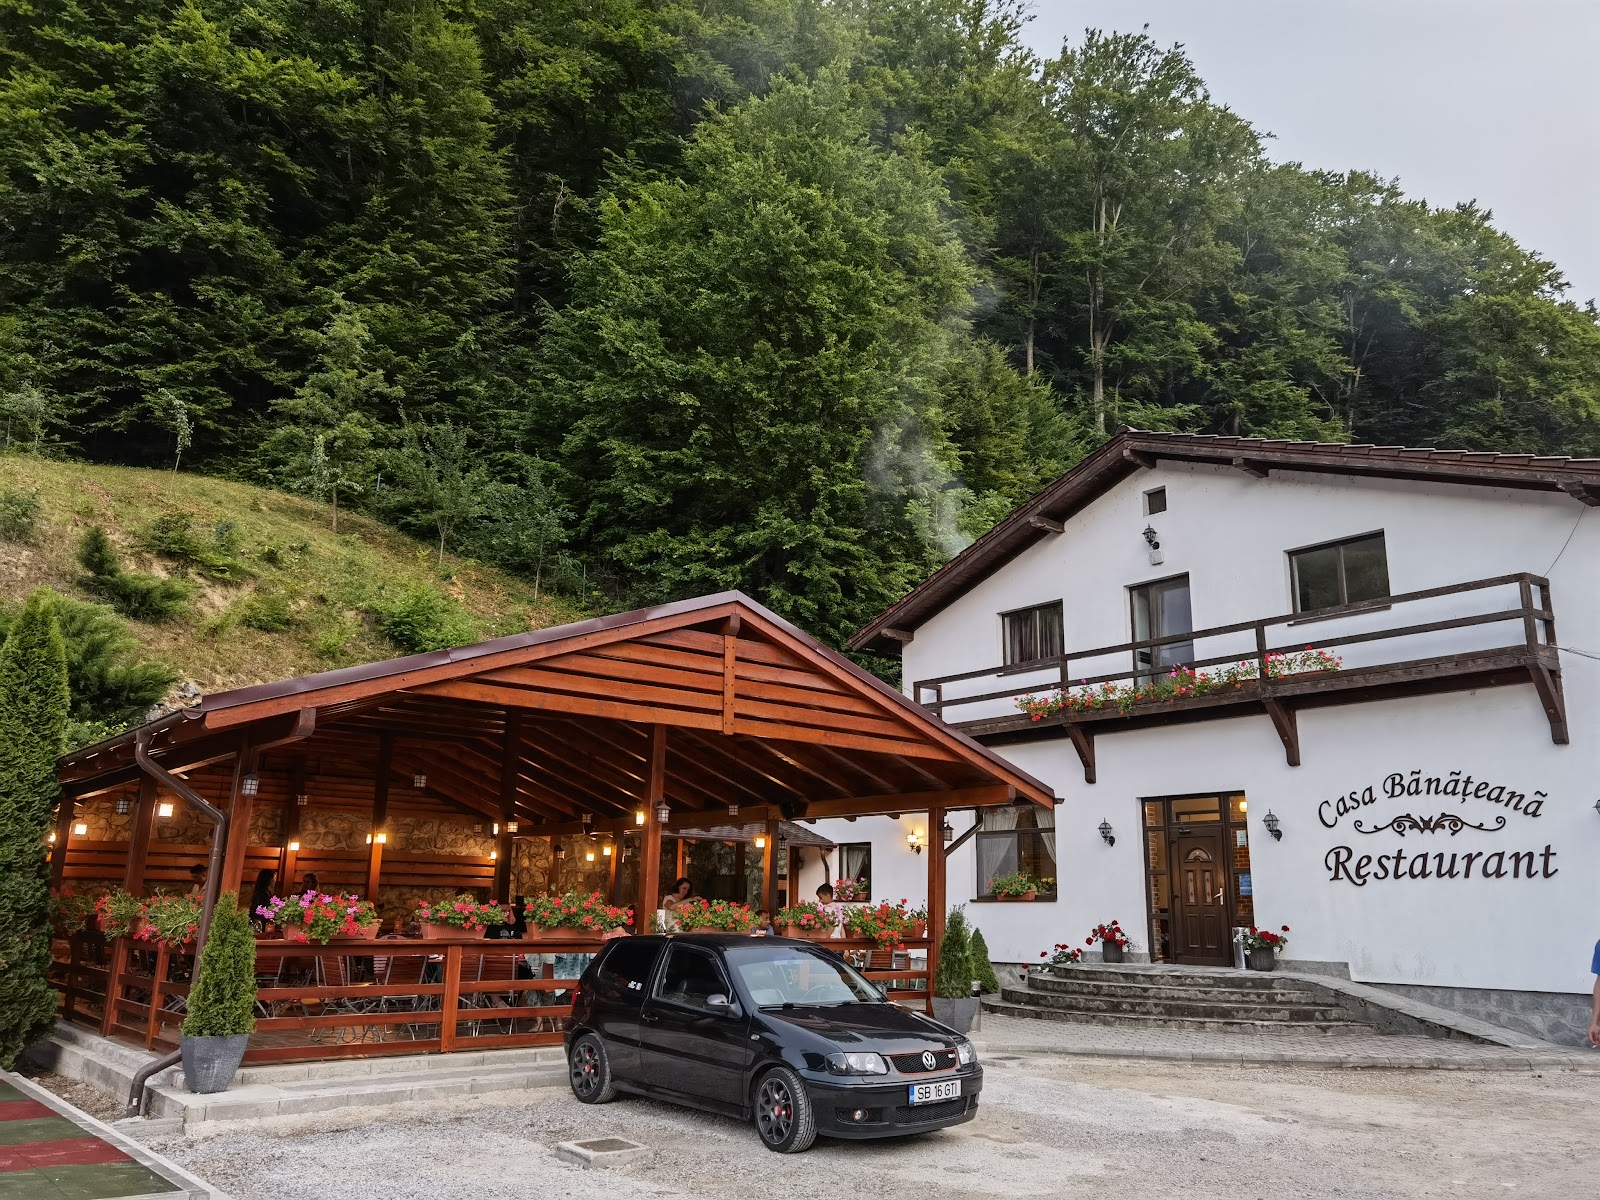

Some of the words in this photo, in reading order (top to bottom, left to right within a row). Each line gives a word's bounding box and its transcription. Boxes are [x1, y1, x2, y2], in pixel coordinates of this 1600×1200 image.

[1318, 785, 1377, 829] Casa
[1324, 844, 1559, 887] Restaurant
[917, 1086, 931, 1100] SB
[934, 1084, 943, 1098] 16
[944, 1082, 958, 1096] GTI
